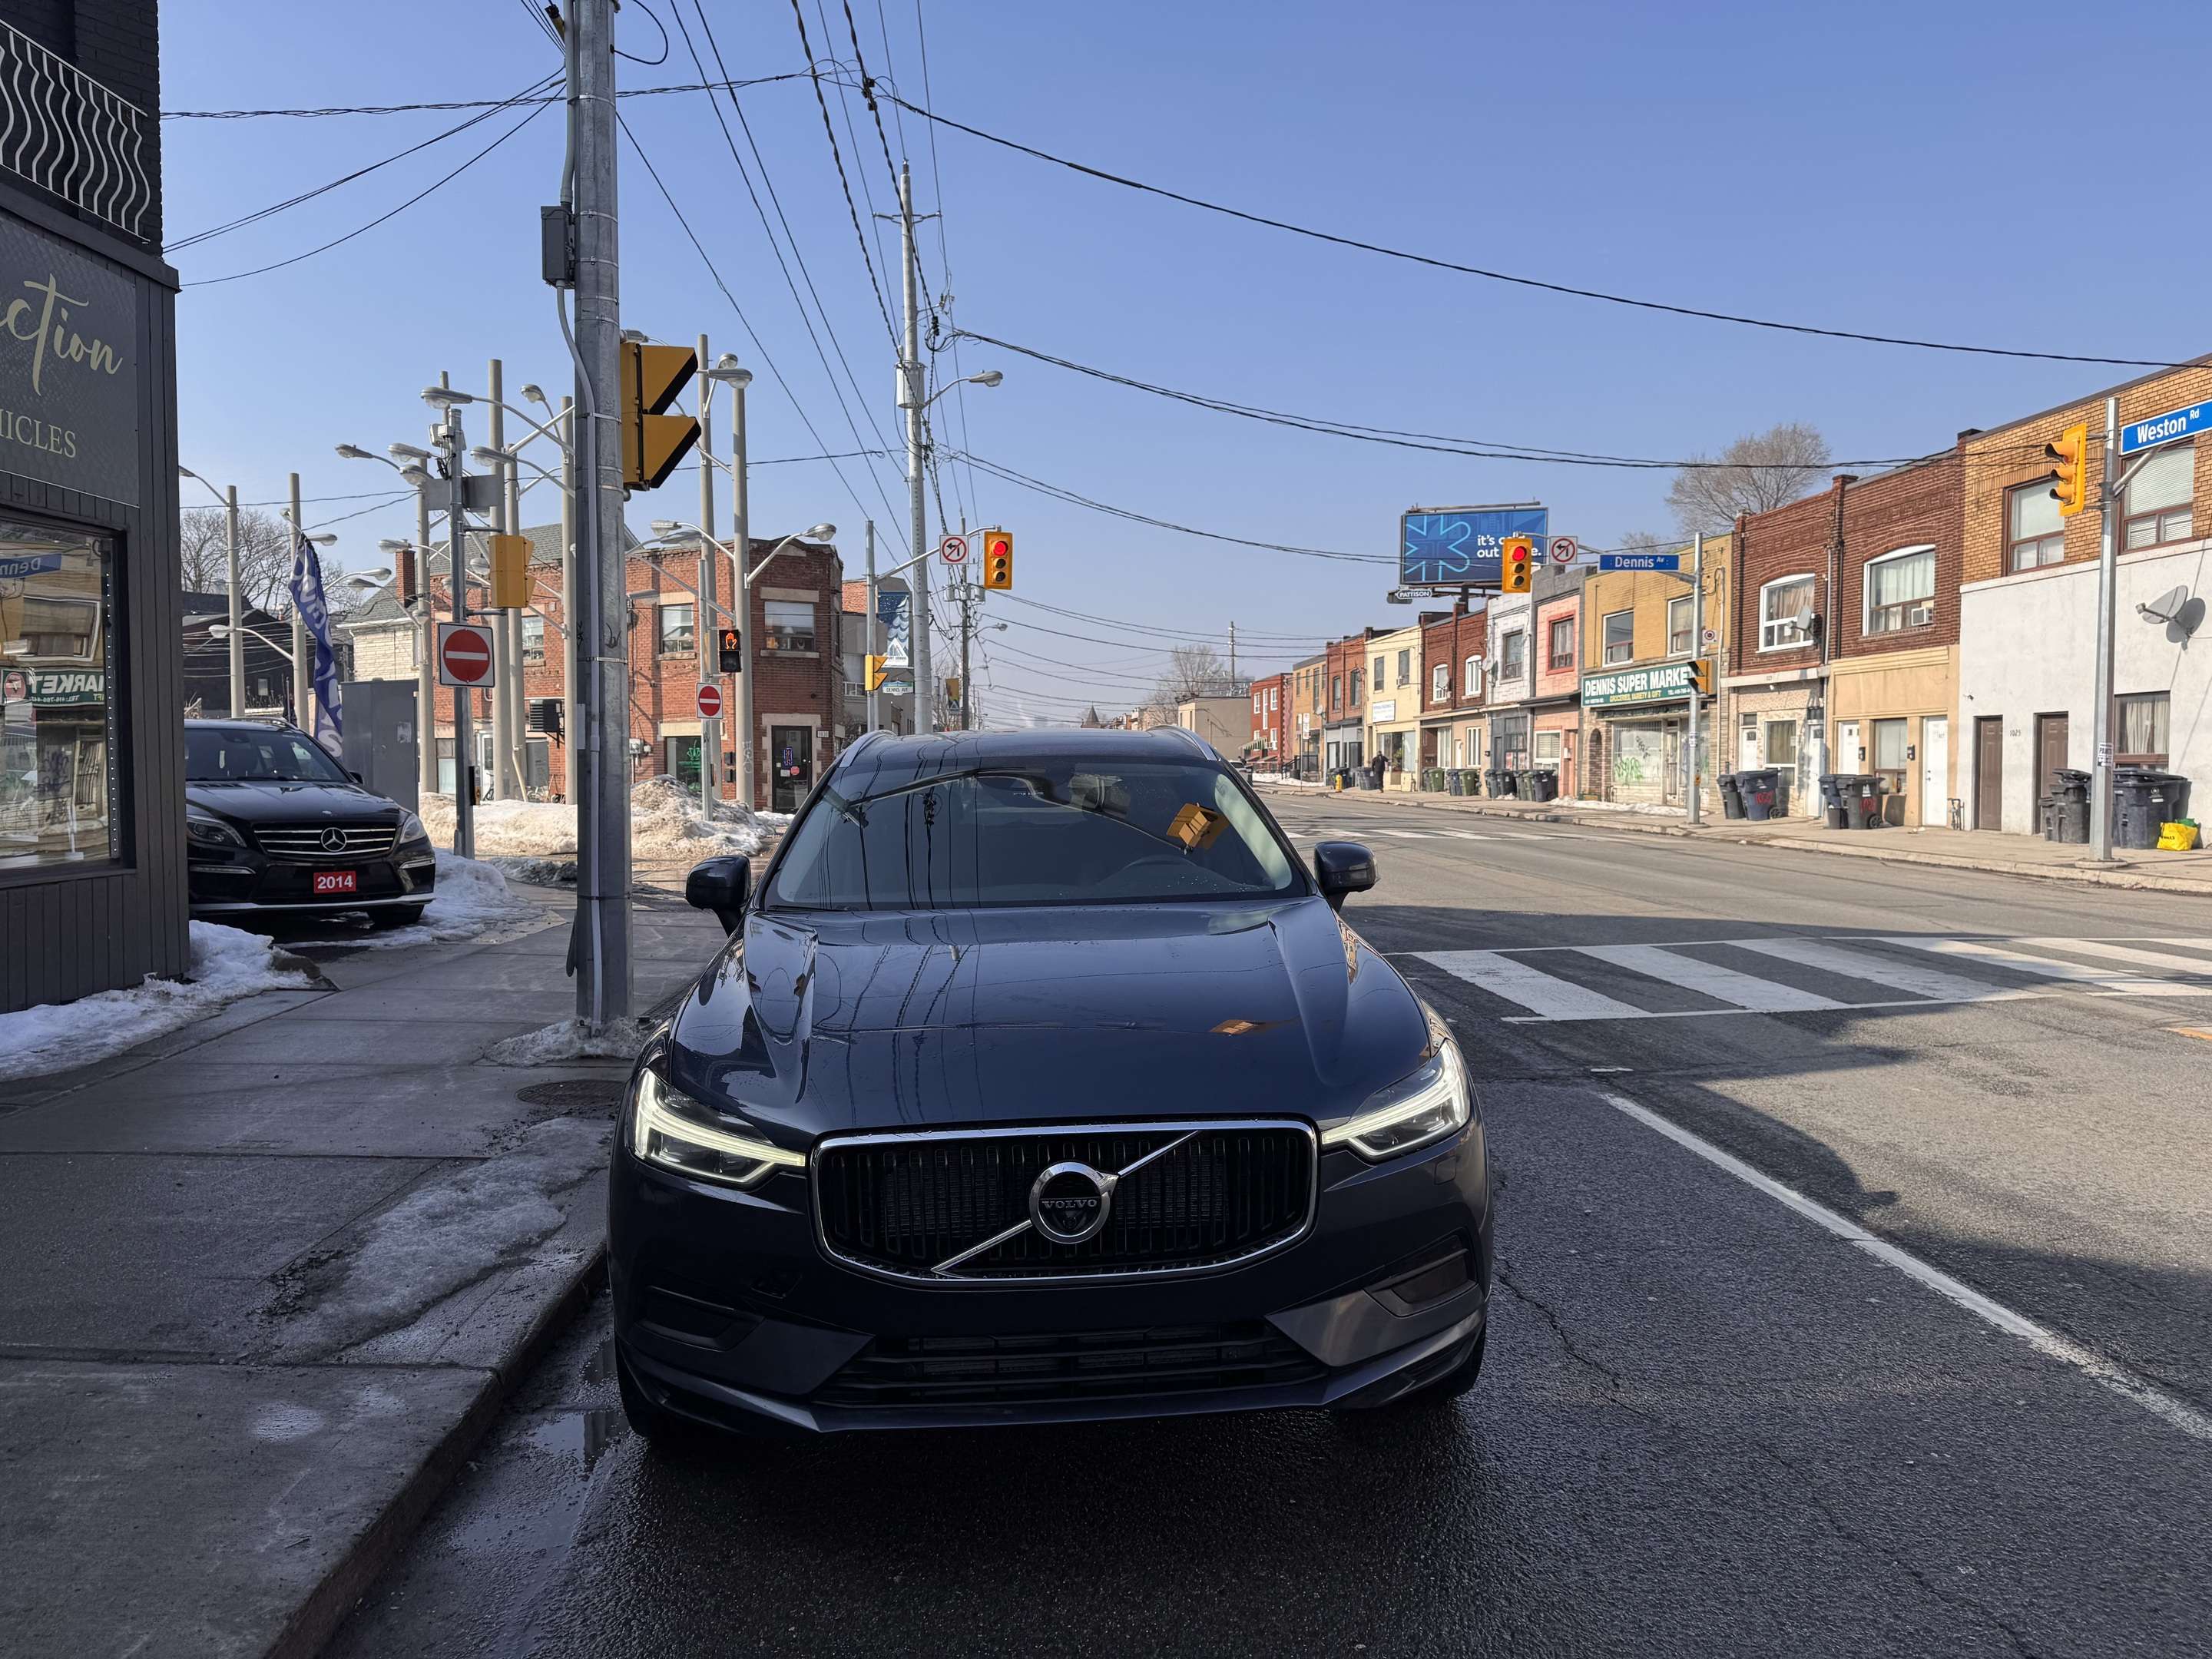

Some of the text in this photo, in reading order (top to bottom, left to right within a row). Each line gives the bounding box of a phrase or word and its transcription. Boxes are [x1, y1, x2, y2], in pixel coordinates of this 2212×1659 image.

[0, 273, 123, 396] ction
[2137, 408, 2200, 443] Weston Rd
[1478, 535, 1495, 546] it's
[1477, 547, 1499, 558] out
[1614, 556, 1654, 568] Dennis
[1585, 677, 1616, 697] DENNIS
[1617, 673, 1647, 694] SUPER
[317, 875, 353, 889] 2014
[1041, 1199, 1098, 1209] VOLVO
